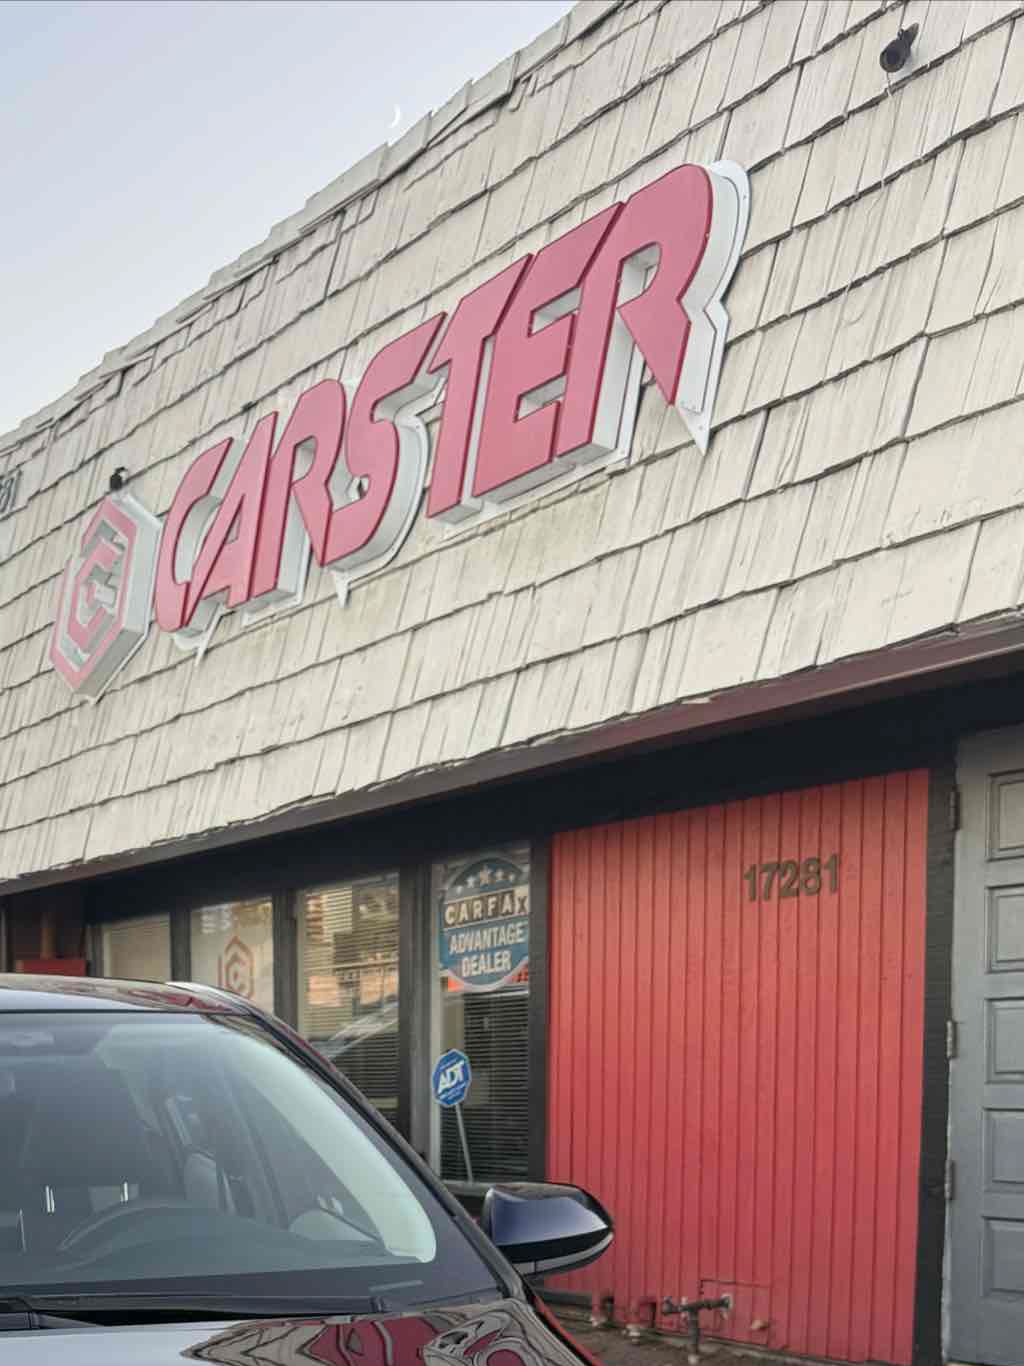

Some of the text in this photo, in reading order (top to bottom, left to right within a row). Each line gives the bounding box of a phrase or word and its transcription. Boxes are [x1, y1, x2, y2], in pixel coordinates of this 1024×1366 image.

[153, 162, 718, 635] CARSTER
[742, 852, 841, 902] 17281
[444, 891, 528, 925] CARFAX
[449, 921, 524, 955] ADVANTAGE
[461, 949, 512, 977] DEALER
[438, 1060, 465, 1094] ADT
